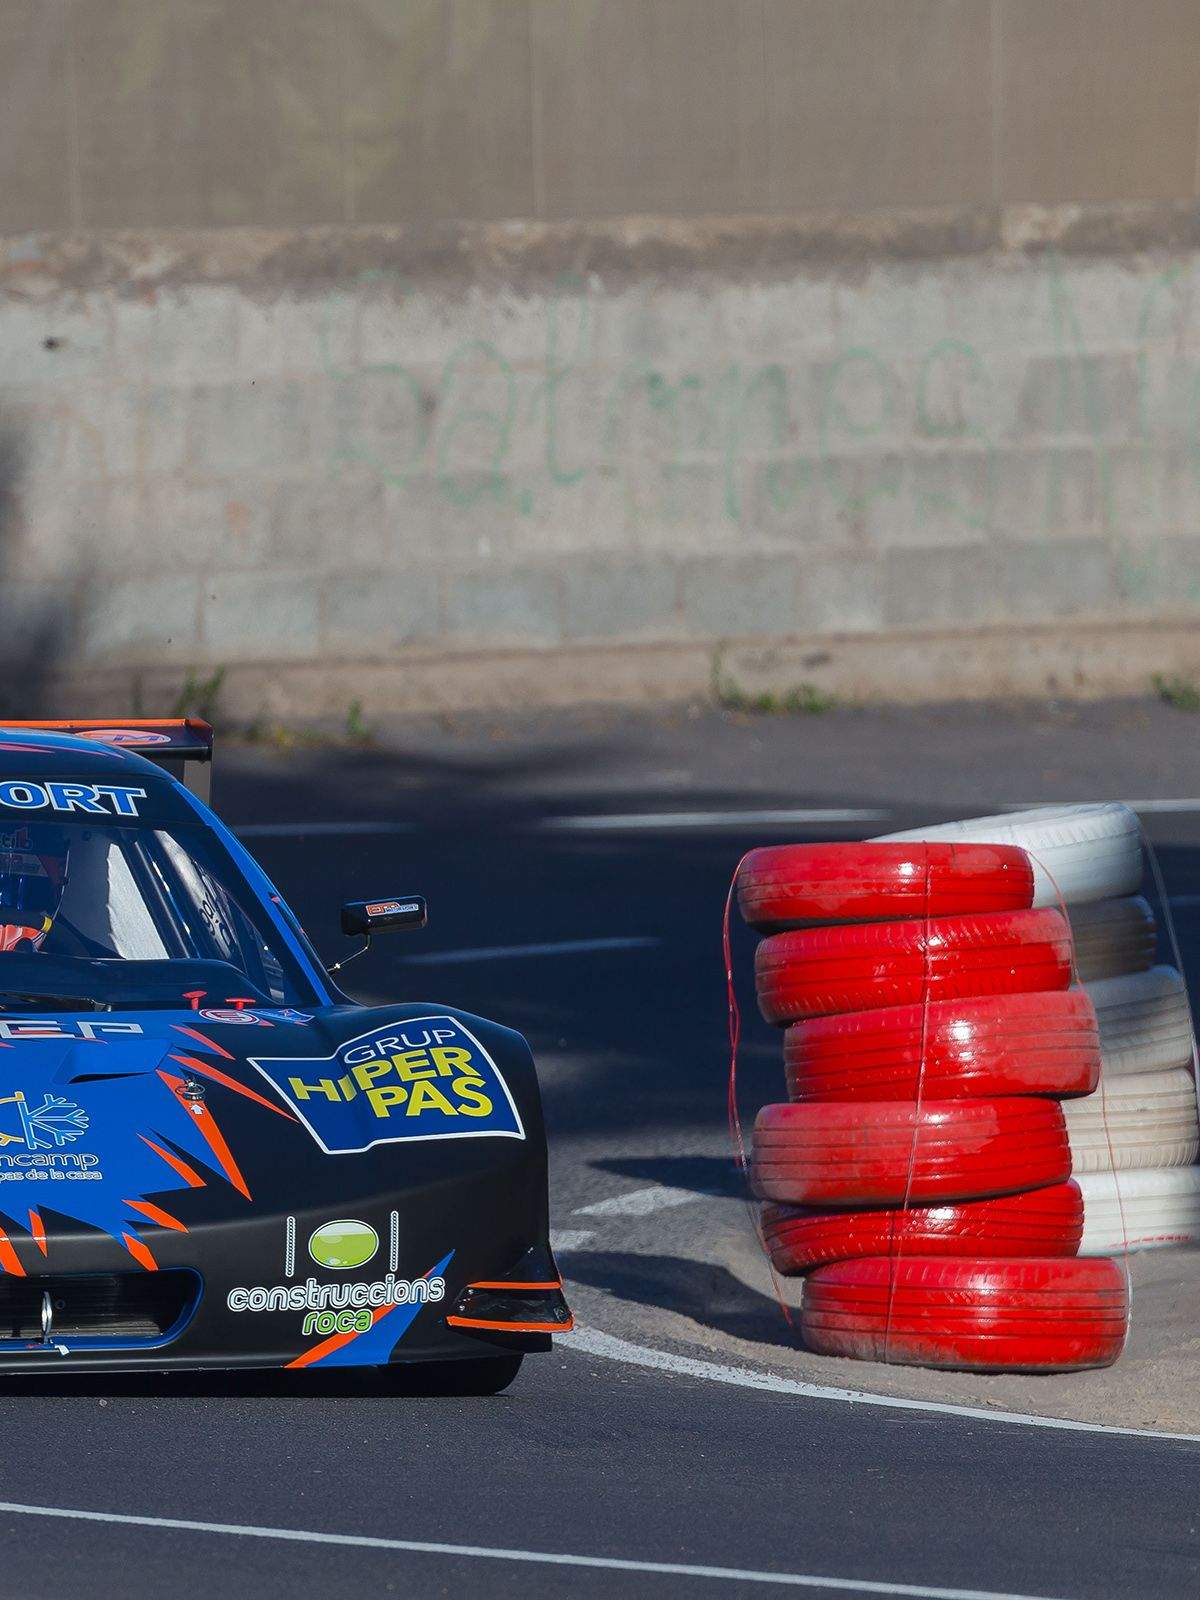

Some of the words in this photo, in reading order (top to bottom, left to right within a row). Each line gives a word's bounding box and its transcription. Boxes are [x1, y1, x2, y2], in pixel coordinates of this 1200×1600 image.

[344, 1028, 456, 1063] GRUP
[288, 1047, 482, 1101] HIPER
[365, 1076, 493, 1118] PAS
[25, 1169, 48, 1180] de
[50, 1169, 65, 1180] la
[66, 1170, 102, 1180] casa
[227, 1273, 446, 1312] construccions
[302, 1309, 373, 1335] roca
